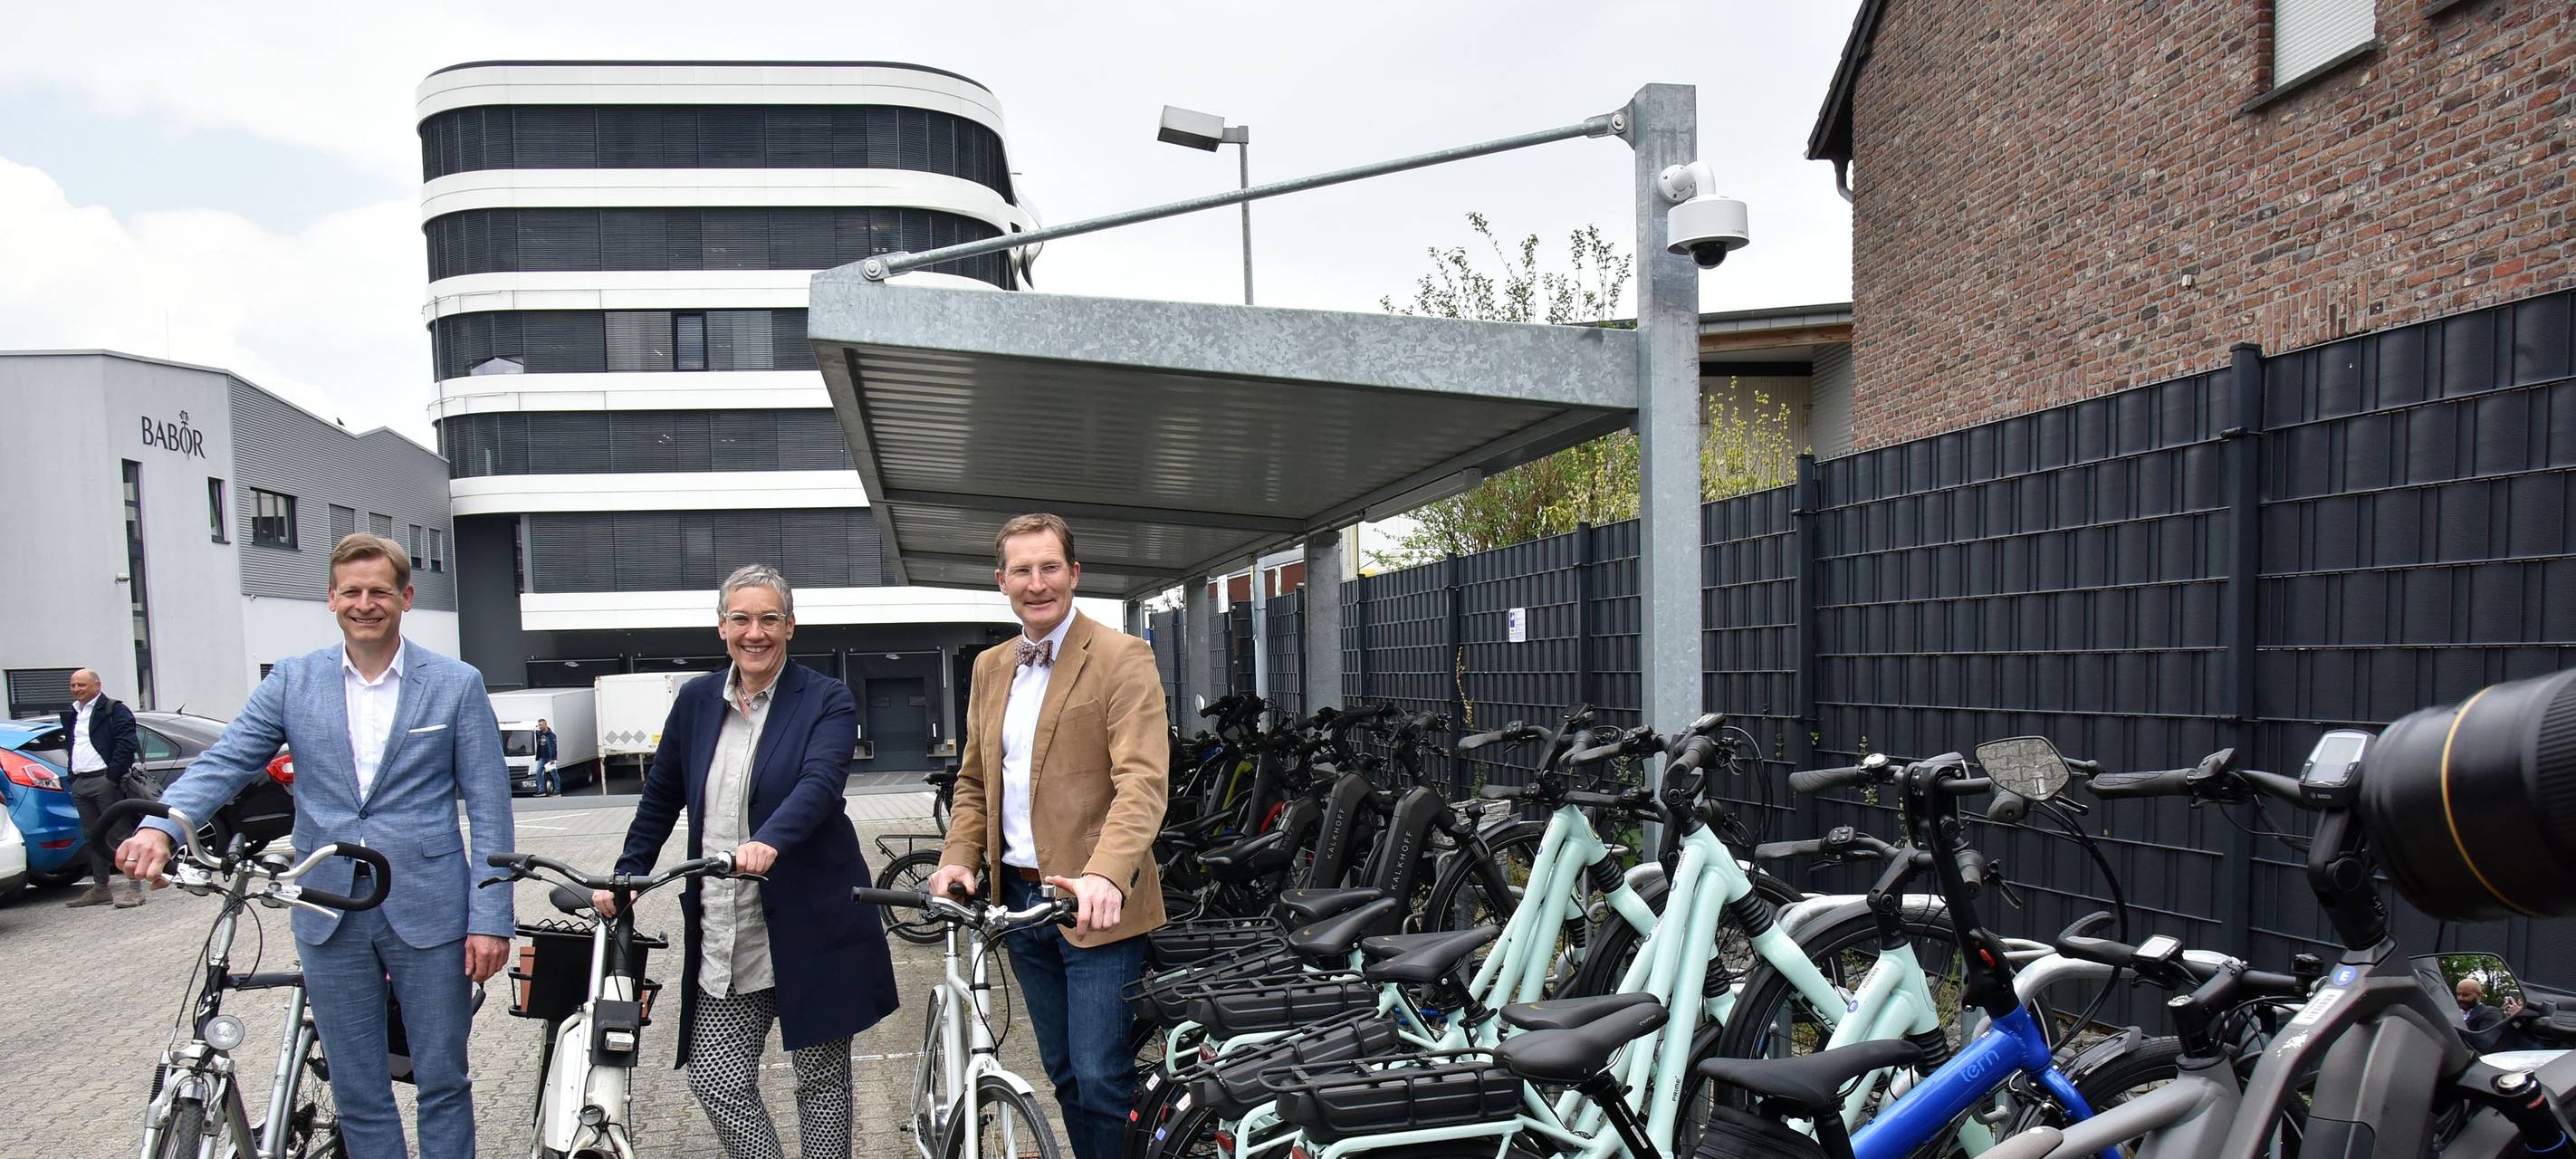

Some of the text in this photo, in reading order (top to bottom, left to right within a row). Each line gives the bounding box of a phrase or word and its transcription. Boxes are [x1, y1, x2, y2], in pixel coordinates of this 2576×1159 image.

[141, 416, 206, 459] BABOR
[1326, 808, 1345, 860] KALKHOFF
[1390, 829, 1412, 891] KALKHOFF
[2339, 971, 2351, 982] E
[1959, 1050, 2000, 1083] tern
[1671, 1078, 1682, 1102] PRIME
